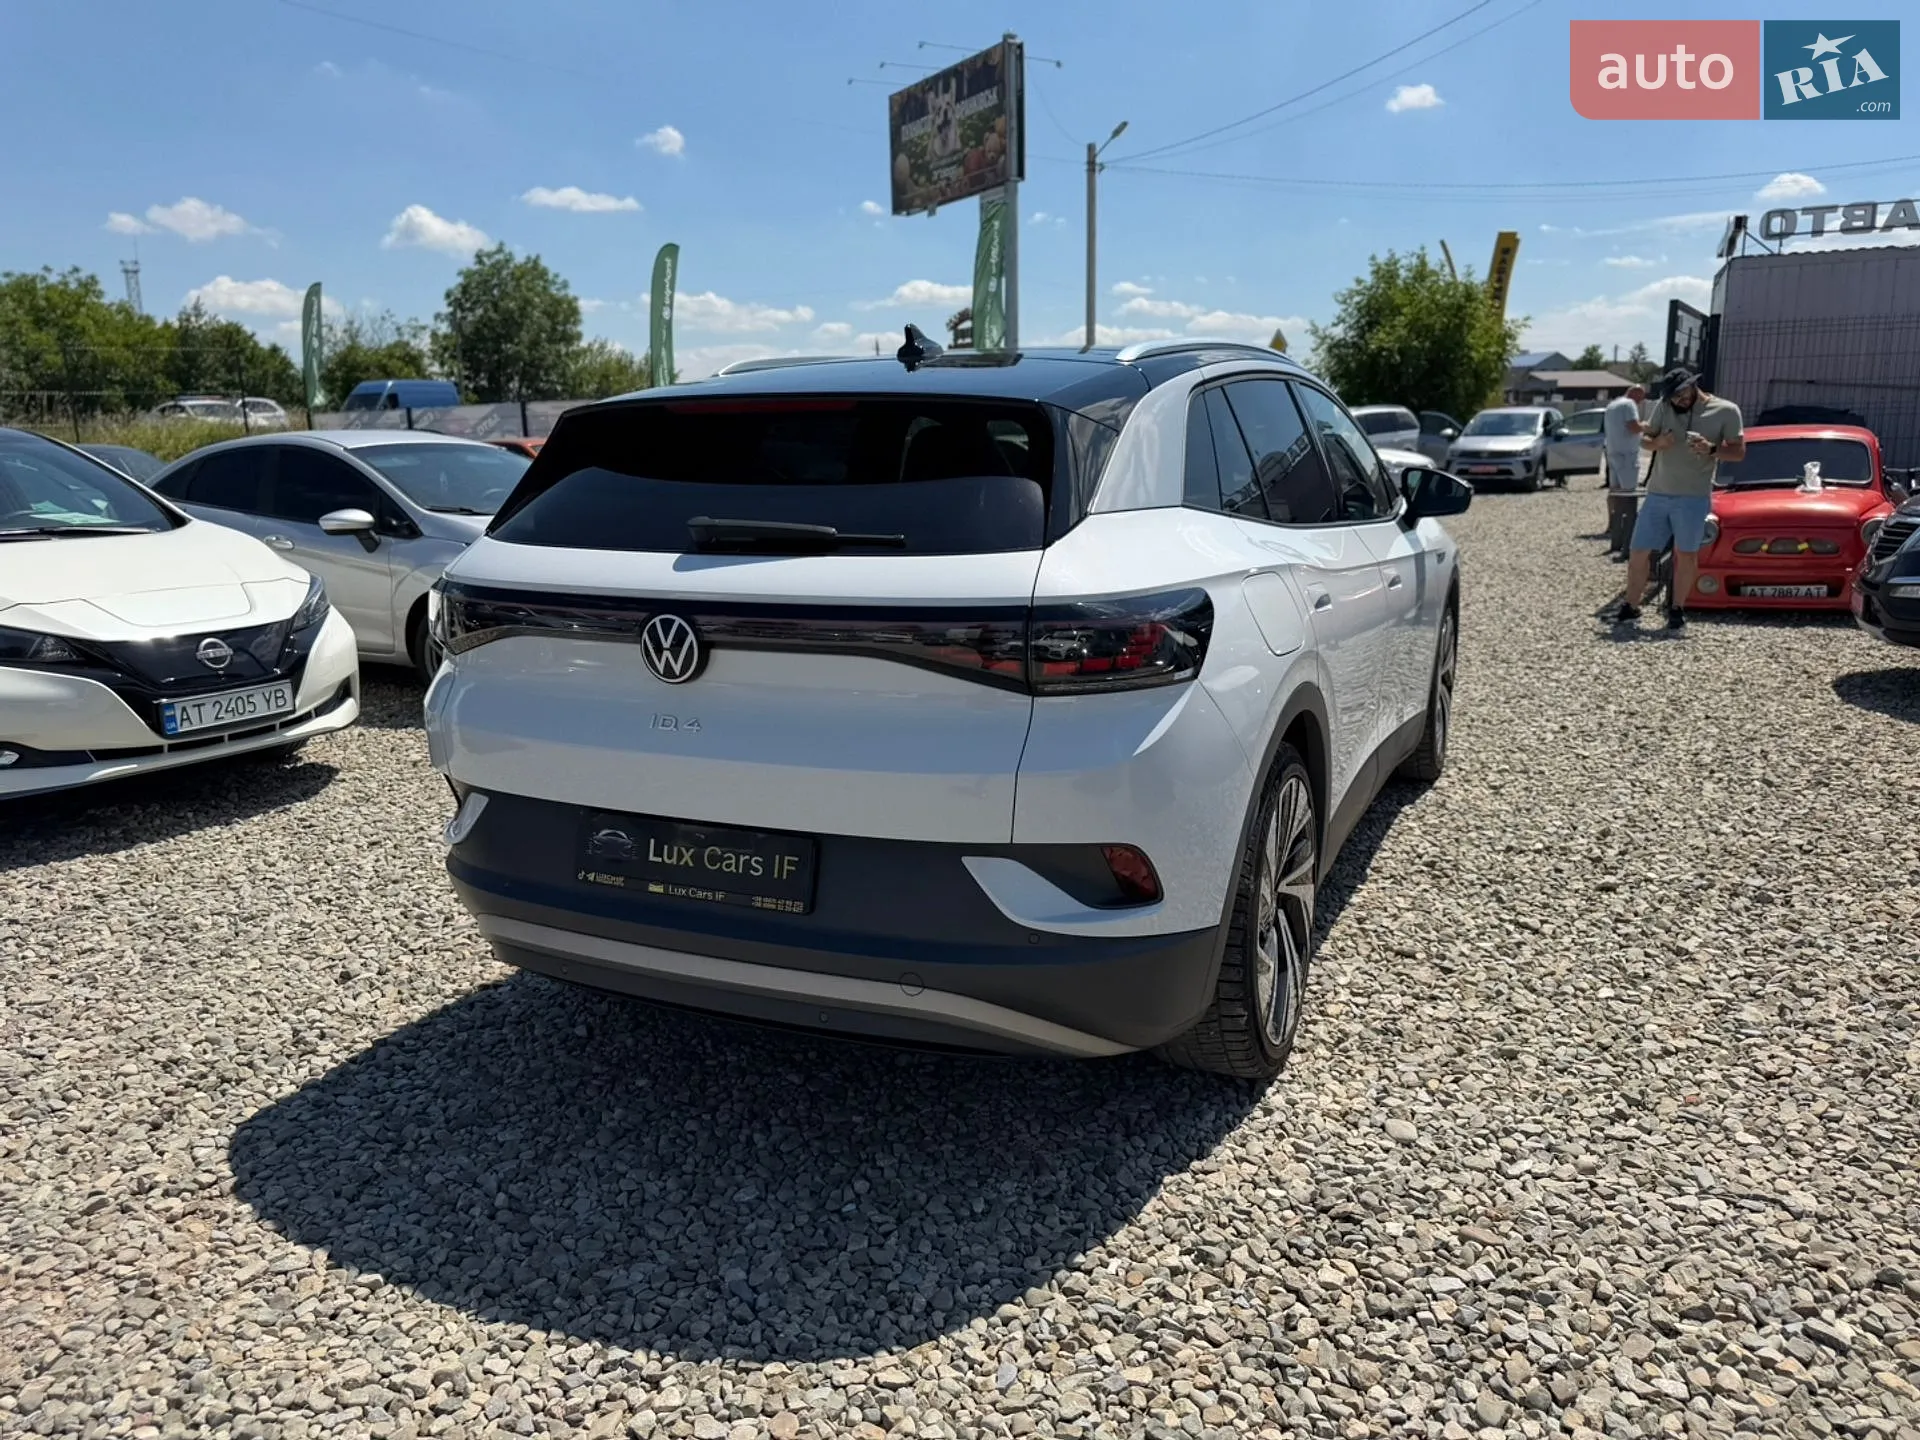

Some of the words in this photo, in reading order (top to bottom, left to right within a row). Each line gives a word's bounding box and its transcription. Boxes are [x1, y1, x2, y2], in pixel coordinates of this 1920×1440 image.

[180, 703, 206, 727] AT
[212, 694, 257, 721] 2405
[262, 688, 287, 711] YB
[648, 838, 695, 867] Lux
[704, 846, 765, 877] Cars
[773, 854, 800, 880] IF
[669, 884, 688, 896] Lux
[689, 887, 713, 900] Cars
[715, 891, 727, 902] IF
